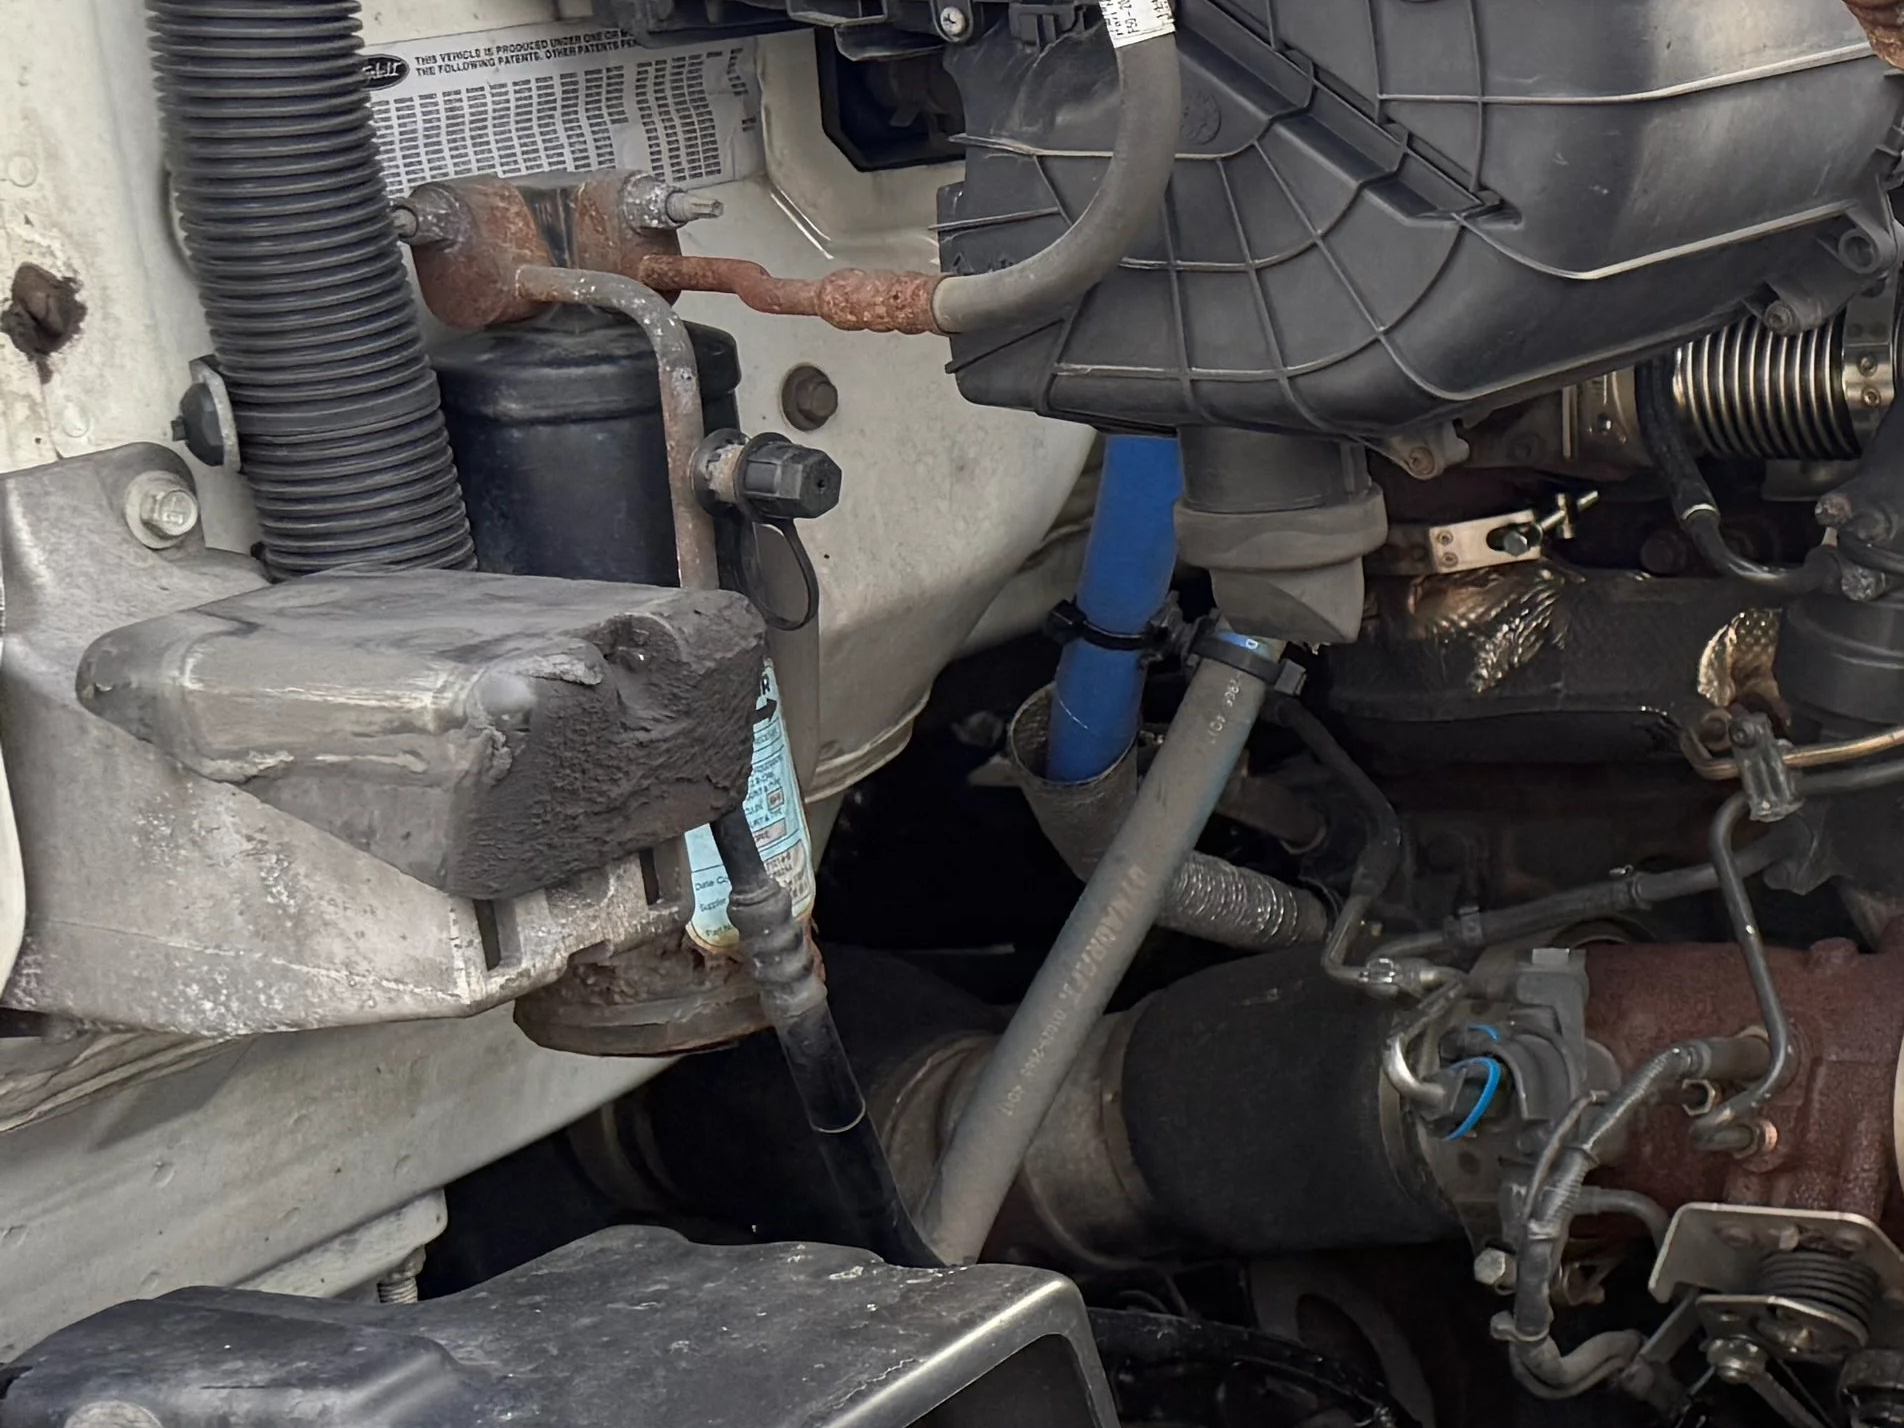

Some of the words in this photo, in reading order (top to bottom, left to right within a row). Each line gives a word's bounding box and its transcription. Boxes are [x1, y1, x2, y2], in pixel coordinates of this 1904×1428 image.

[415, 54, 437, 65] THIS
[439, 48, 481, 65] VEHICLE
[484, 47, 493, 58] IS
[495, 40, 548, 55] PRODUCED
[550, 36, 581, 48] UNDER
[583, 32, 603, 44] ONE
[415, 67, 436, 78] THE
[438, 57, 496, 74] FOLLOWING
[545, 45, 576, 59] OTHER
[577, 41, 619, 56] PATENTS
